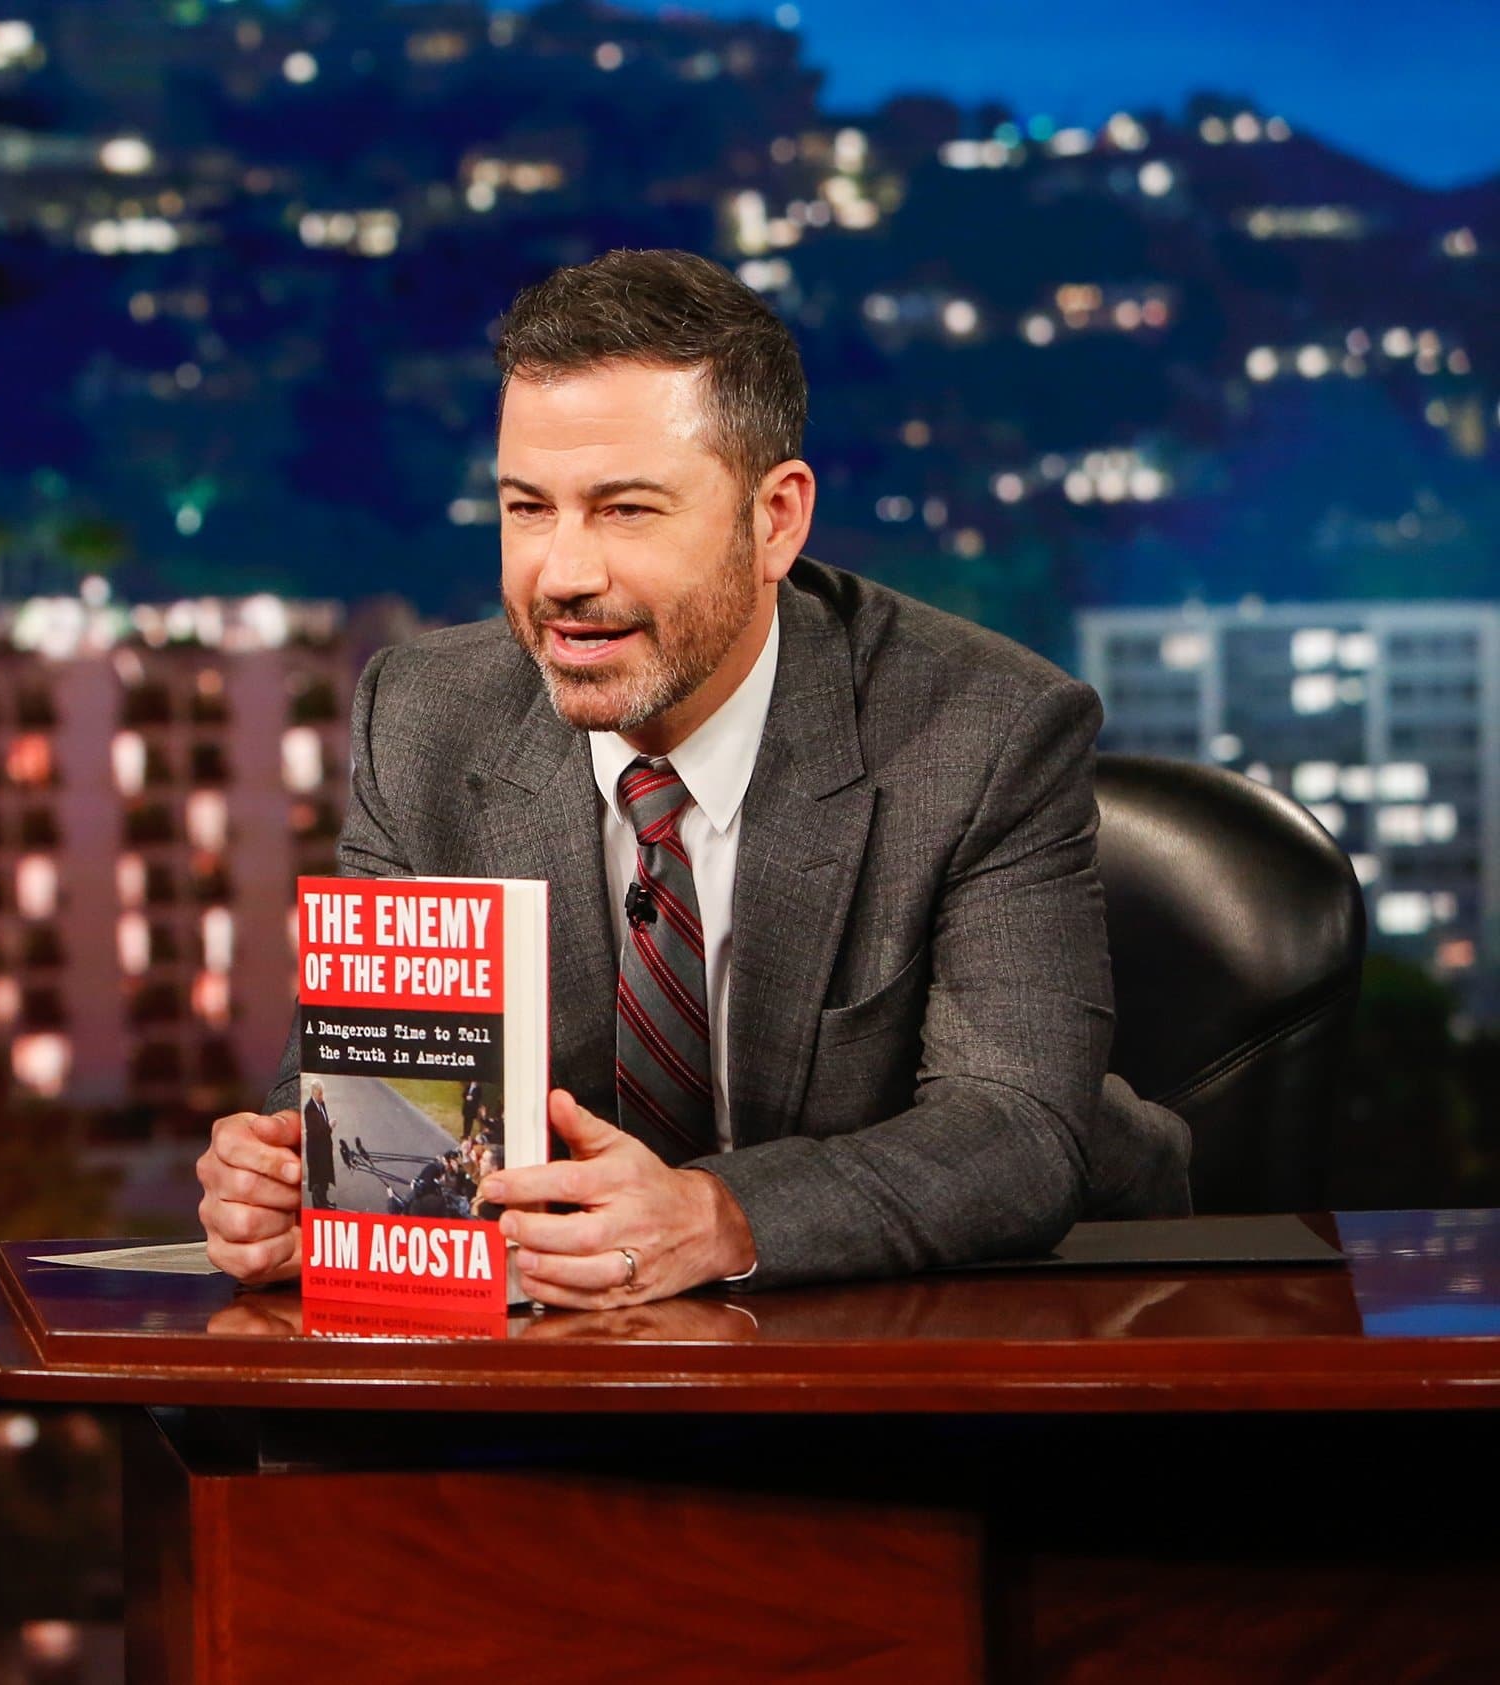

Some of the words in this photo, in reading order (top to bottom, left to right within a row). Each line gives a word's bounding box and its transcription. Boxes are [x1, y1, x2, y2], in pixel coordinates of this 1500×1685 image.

[304, 893, 363, 945] THE
[375, 895, 492, 949] ENEMY
[305, 952, 333, 991] OF
[340, 954, 386, 994] THE
[394, 956, 491, 998] PEOPLE
[305, 1021, 313, 1034] A
[318, 1020, 387, 1039] Dangerous
[394, 1024, 427, 1040] Time
[434, 1026, 450, 1041] to
[458, 1027, 491, 1043] Tell
[319, 1045, 340, 1060] the
[347, 1046, 386, 1063] Truth
[393, 1049, 409, 1063] in
[416, 1051, 475, 1067] America
[310, 1219, 359, 1270] JIM
[369, 1223, 492, 1280] ACOSTA
[310, 1276, 327, 1287] CNN
[329, 1277, 352, 1289] CHIEF
[355, 1279, 380, 1291] WHITE
[382, 1282, 409, 1294] HOUSE
[411, 1285, 492, 1298] CORRESPONDENT
